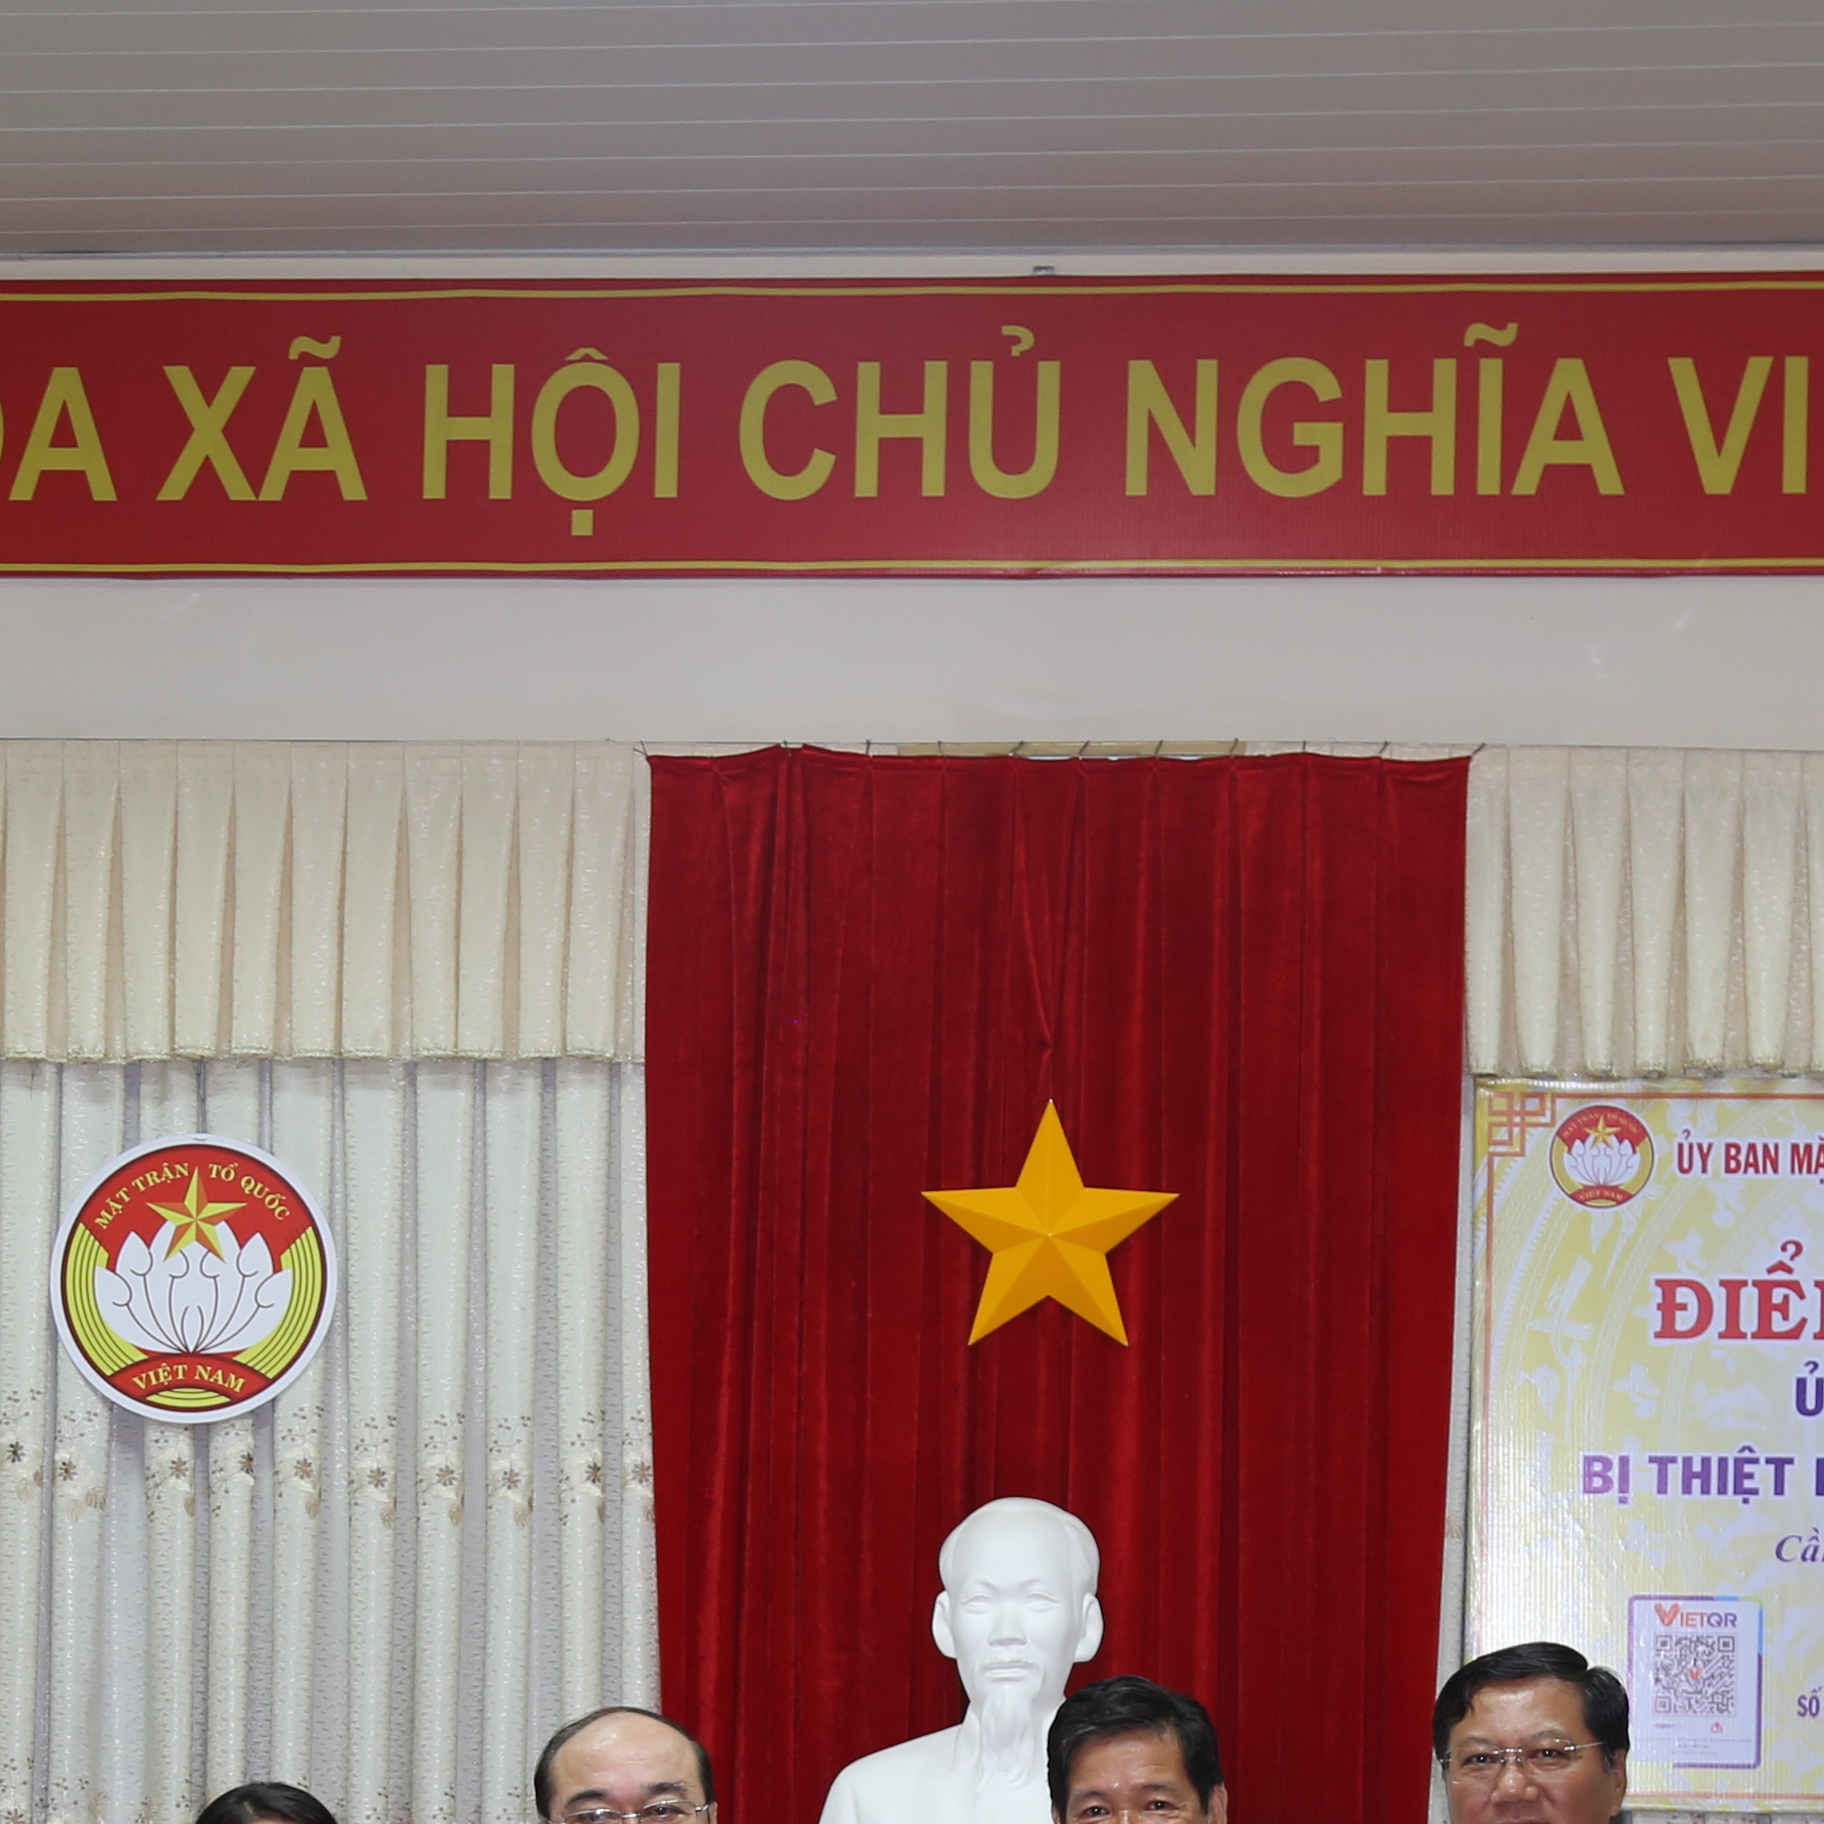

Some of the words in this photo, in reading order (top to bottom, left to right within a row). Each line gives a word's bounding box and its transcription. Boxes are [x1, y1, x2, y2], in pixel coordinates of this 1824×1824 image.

[157, 334, 369, 502] XÃ
[421, 348, 681, 537] HỘI
[738, 326, 1063, 500] CHỦ
[1126, 322, 1625, 498] NGHĨA
[1676, 1129, 1713, 1175] ỦY
[1724, 1142, 1780, 1175] BAN
[94, 1187, 132, 1230] MẶT
[132, 1162, 189, 1193] TRẬN
[208, 1162, 239, 1182] TỔ
[240, 1175, 291, 1221] QUỐC
[132, 1362, 188, 1391] VIỆT
[193, 1364, 246, 1393] NAM
[1581, 1454, 1632, 1507] BỊ
[1647, 1445, 1796, 1506] THIỆT
[1797, 1686, 1824, 1719] SỐ
